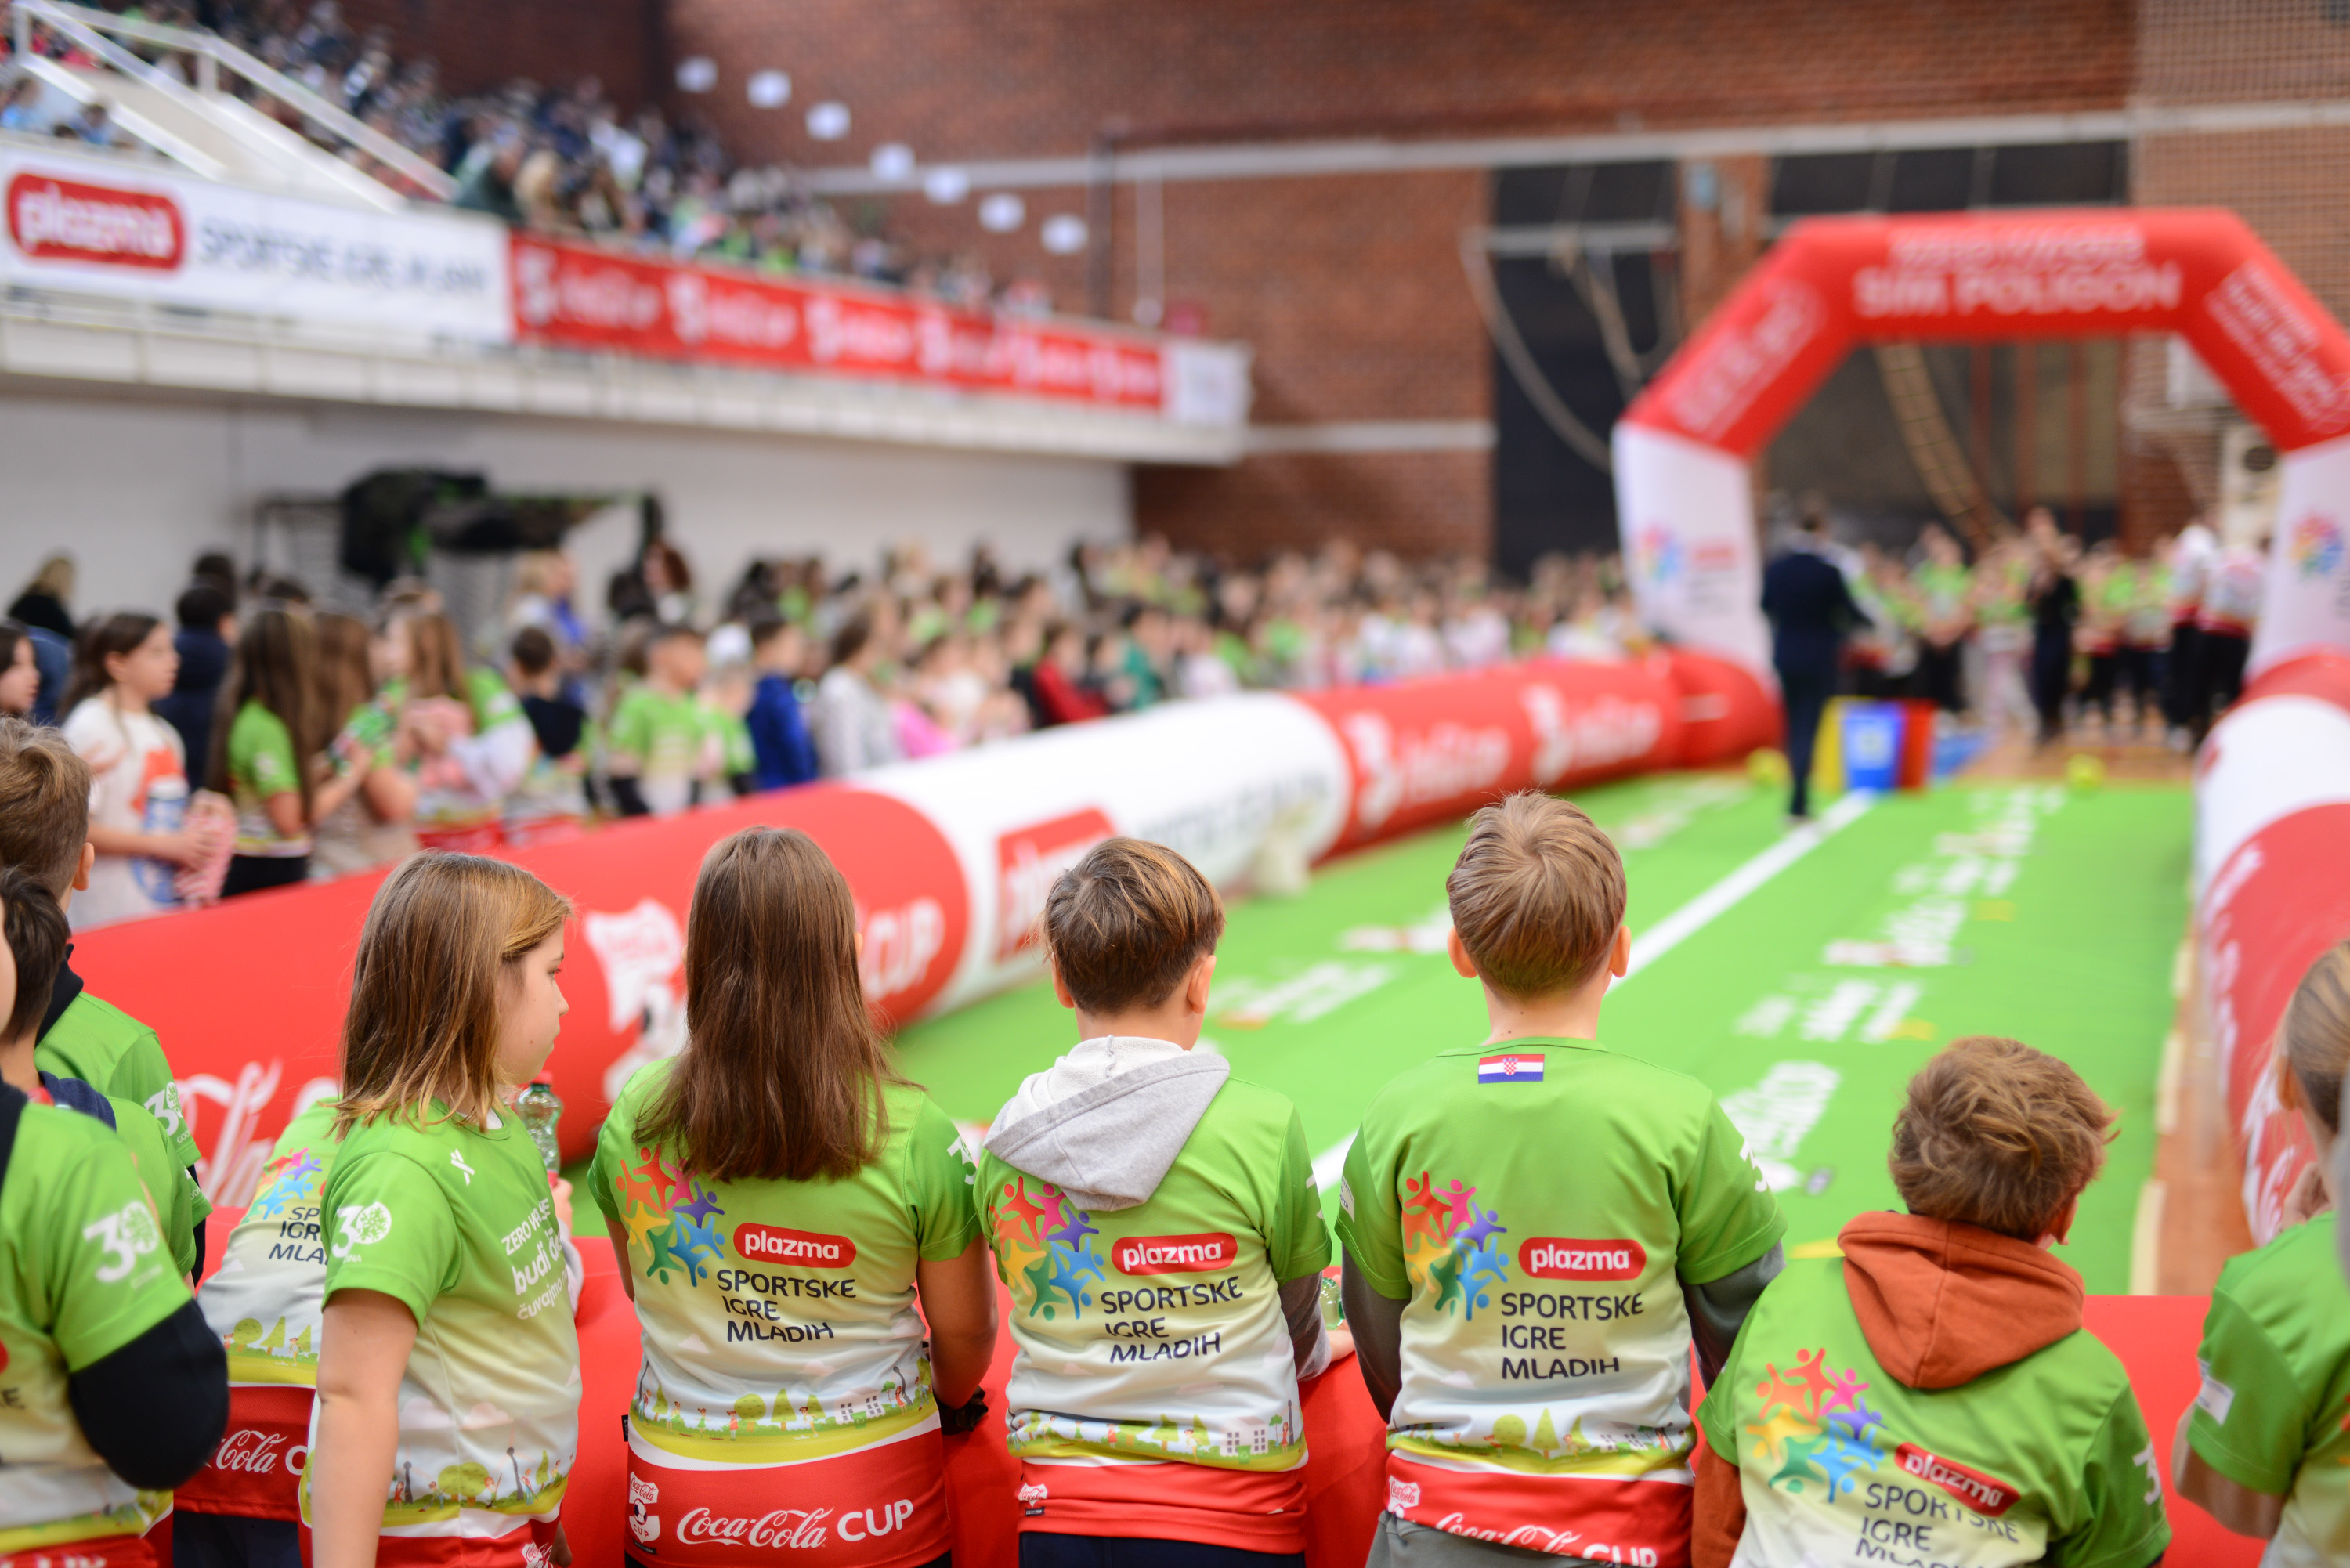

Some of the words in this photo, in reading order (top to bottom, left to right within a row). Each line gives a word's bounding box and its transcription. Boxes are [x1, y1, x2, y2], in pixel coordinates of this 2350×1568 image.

[280, 1221, 320, 1241] IGR
[501, 1221, 532, 1256] ZERO
[745, 1230, 840, 1259] plazma
[269, 1243, 328, 1266] MLA
[512, 1240, 551, 1296] budi
[1123, 1242, 1222, 1272] plazma
[1531, 1243, 1629, 1274] plazma
[717, 1269, 857, 1299] SPORTSKE
[1101, 1276, 1243, 1314] SPORTSKE
[722, 1295, 780, 1321] IGRE
[1501, 1292, 1644, 1321] SPORTSKE
[727, 1320, 834, 1343] MLADIH
[1105, 1317, 1170, 1339] IGRE
[1502, 1324, 1567, 1350] IGRE
[1109, 1331, 1220, 1364] MLADIH
[1502, 1357, 1619, 1380] MLADIH
[1904, 1454, 2005, 1507] plazma
[633, 1523, 649, 1537] CUP
[677, 1507, 834, 1549] Coca-Cola
[837, 1498, 914, 1542] CUP
[1862, 1516, 1932, 1552] IGRE
